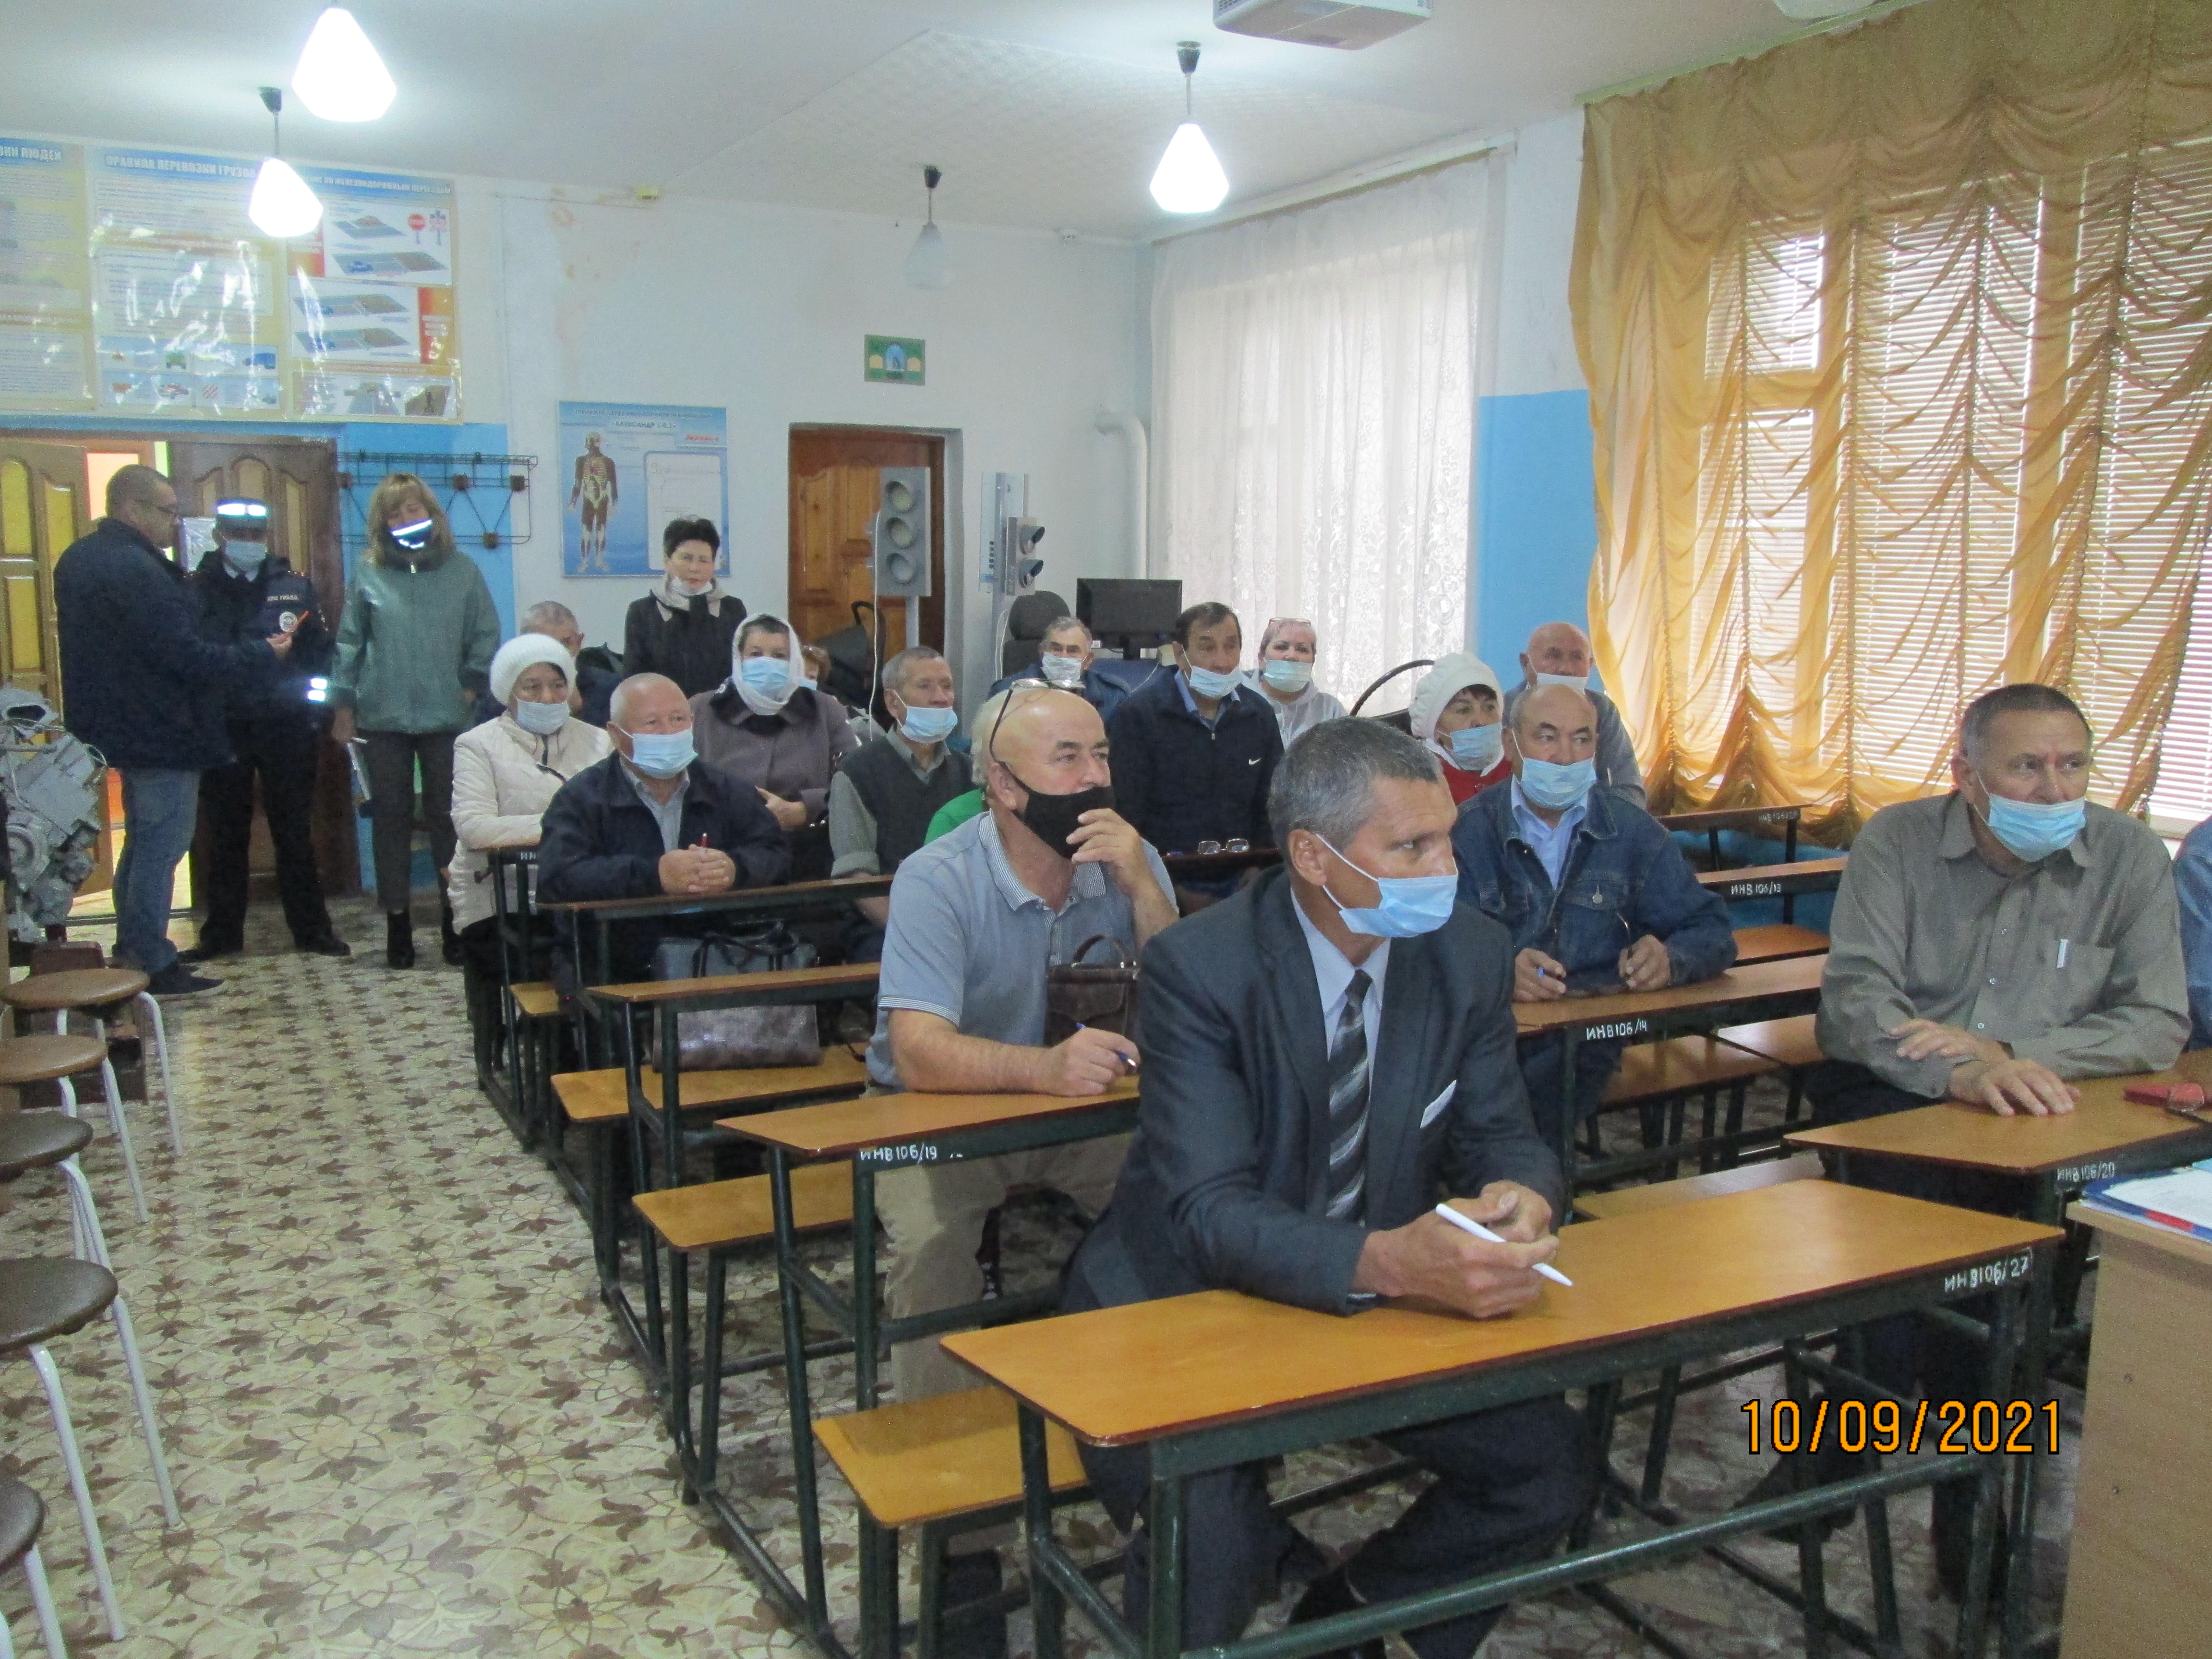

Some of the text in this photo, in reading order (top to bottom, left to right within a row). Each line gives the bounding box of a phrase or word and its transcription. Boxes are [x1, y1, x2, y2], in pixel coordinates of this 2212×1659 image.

[21, 147, 62, 162] ЛЮДЕЙ
[105, 155, 155, 169] ПРАВИЛА
[157, 159, 216, 174] ПЕРЕВОЗКИ
